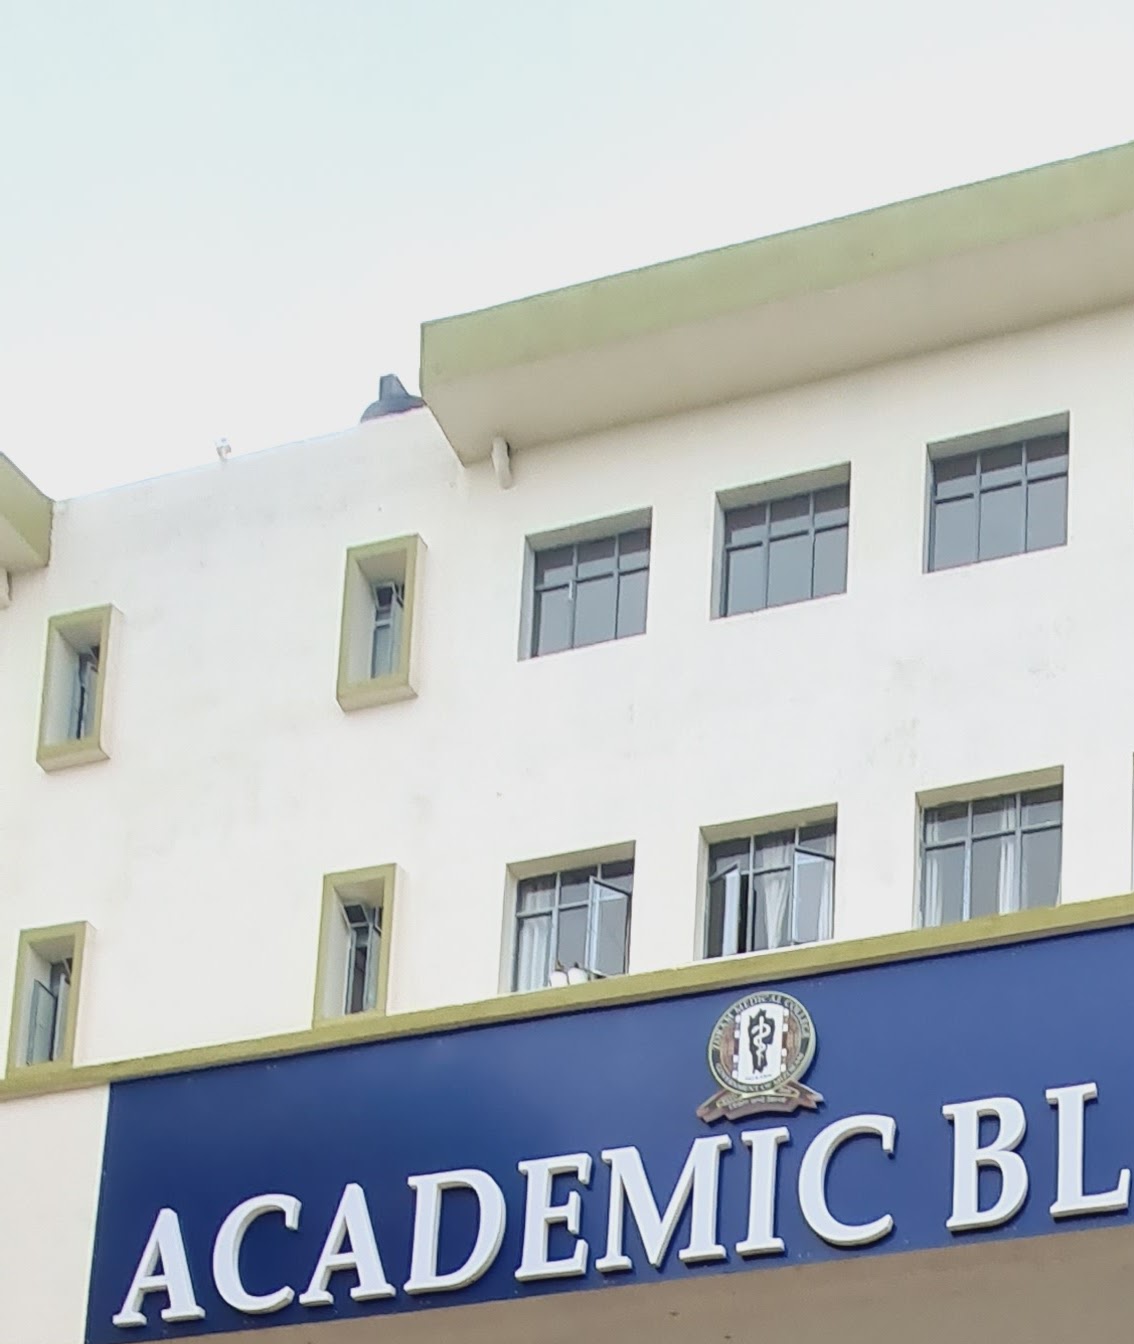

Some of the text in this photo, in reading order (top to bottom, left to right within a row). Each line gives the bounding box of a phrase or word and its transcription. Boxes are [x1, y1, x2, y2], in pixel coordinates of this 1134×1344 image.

[735, 995, 783, 1014] MEDICAL
[784, 998, 811, 1038] COLLEGE
[112, 1114, 898, 1329] ACADEMIC
